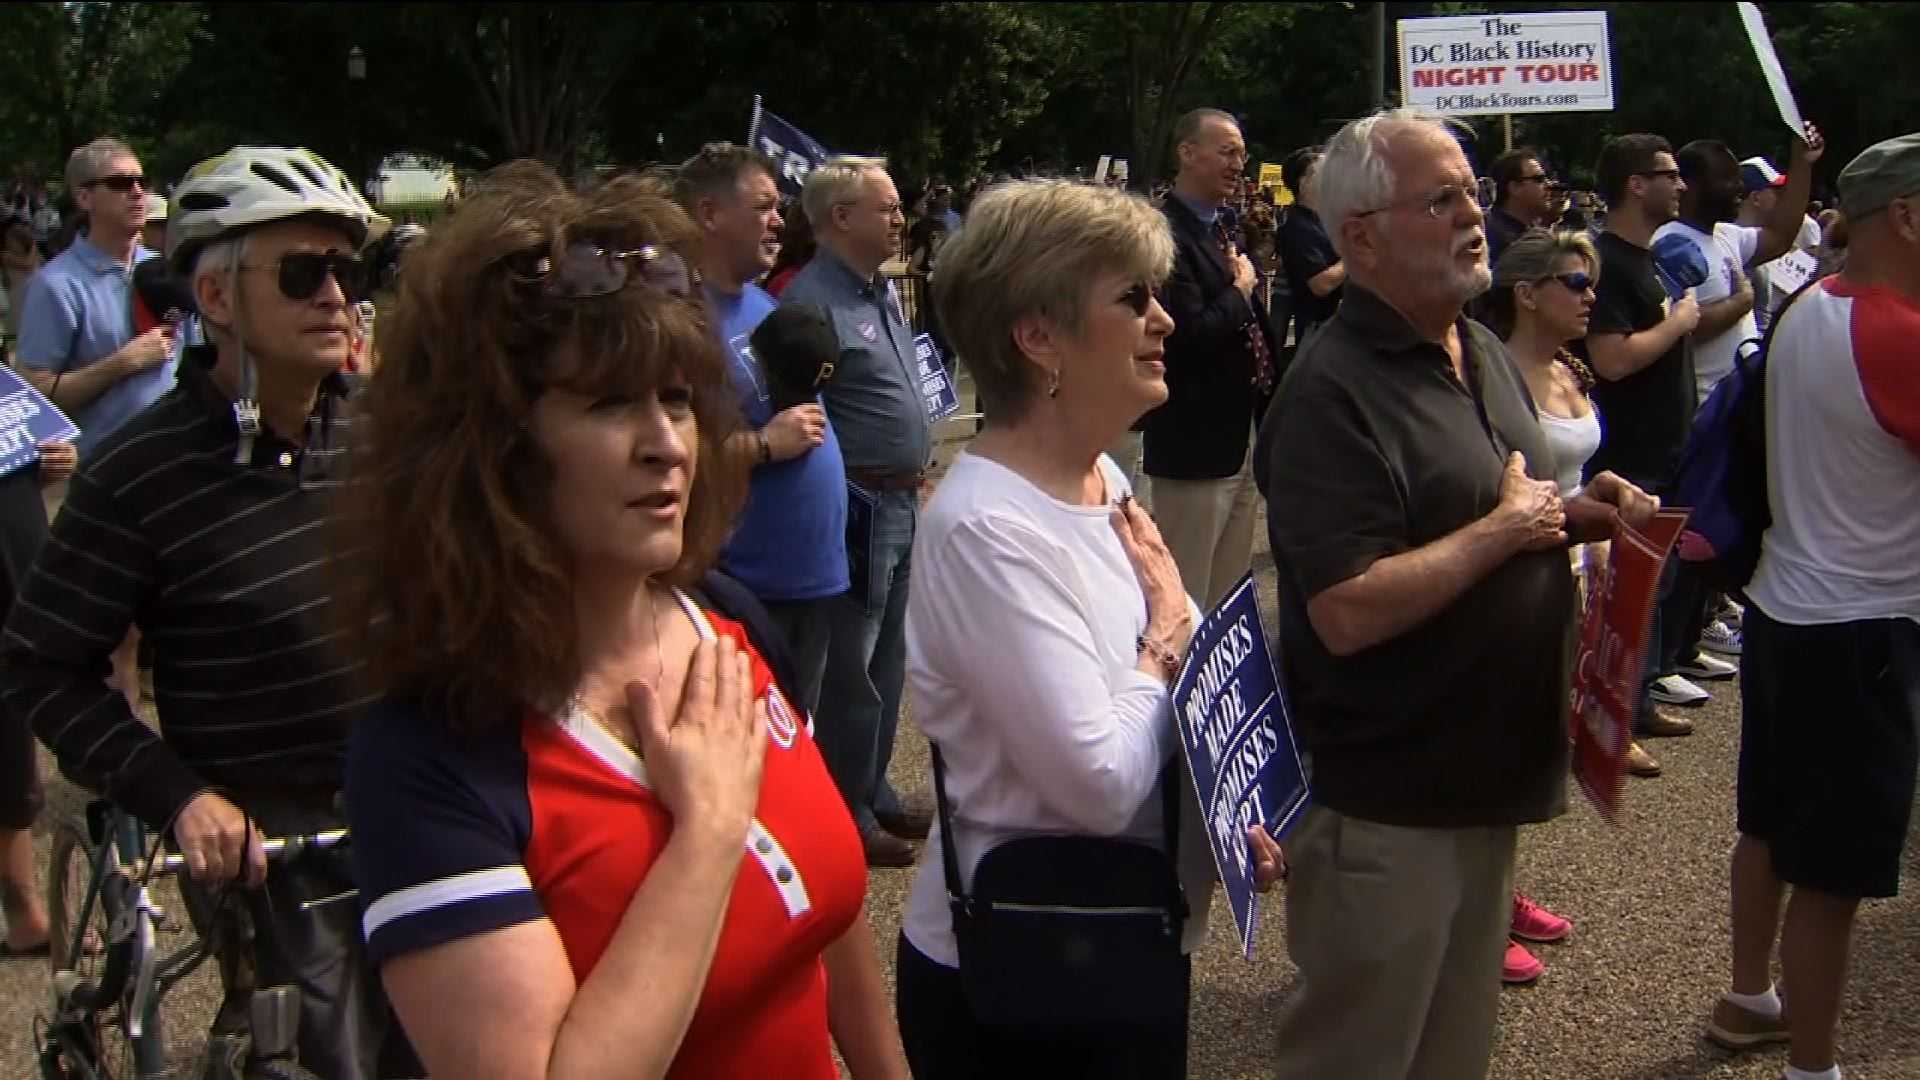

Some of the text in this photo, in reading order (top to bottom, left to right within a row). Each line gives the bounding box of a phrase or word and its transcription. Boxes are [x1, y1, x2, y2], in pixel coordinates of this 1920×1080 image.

[1481, 18, 1522, 37] The
[1411, 40, 1597, 64] DC Black History
[1413, 64, 1599, 88] NIGHT TOUR
[1436, 93, 1578, 110] DCBlackTours.com
[1185, 614, 1254, 750] PROMISES
[1205, 681, 1247, 773] MADE
[1215, 714, 1278, 862] PROMISES
